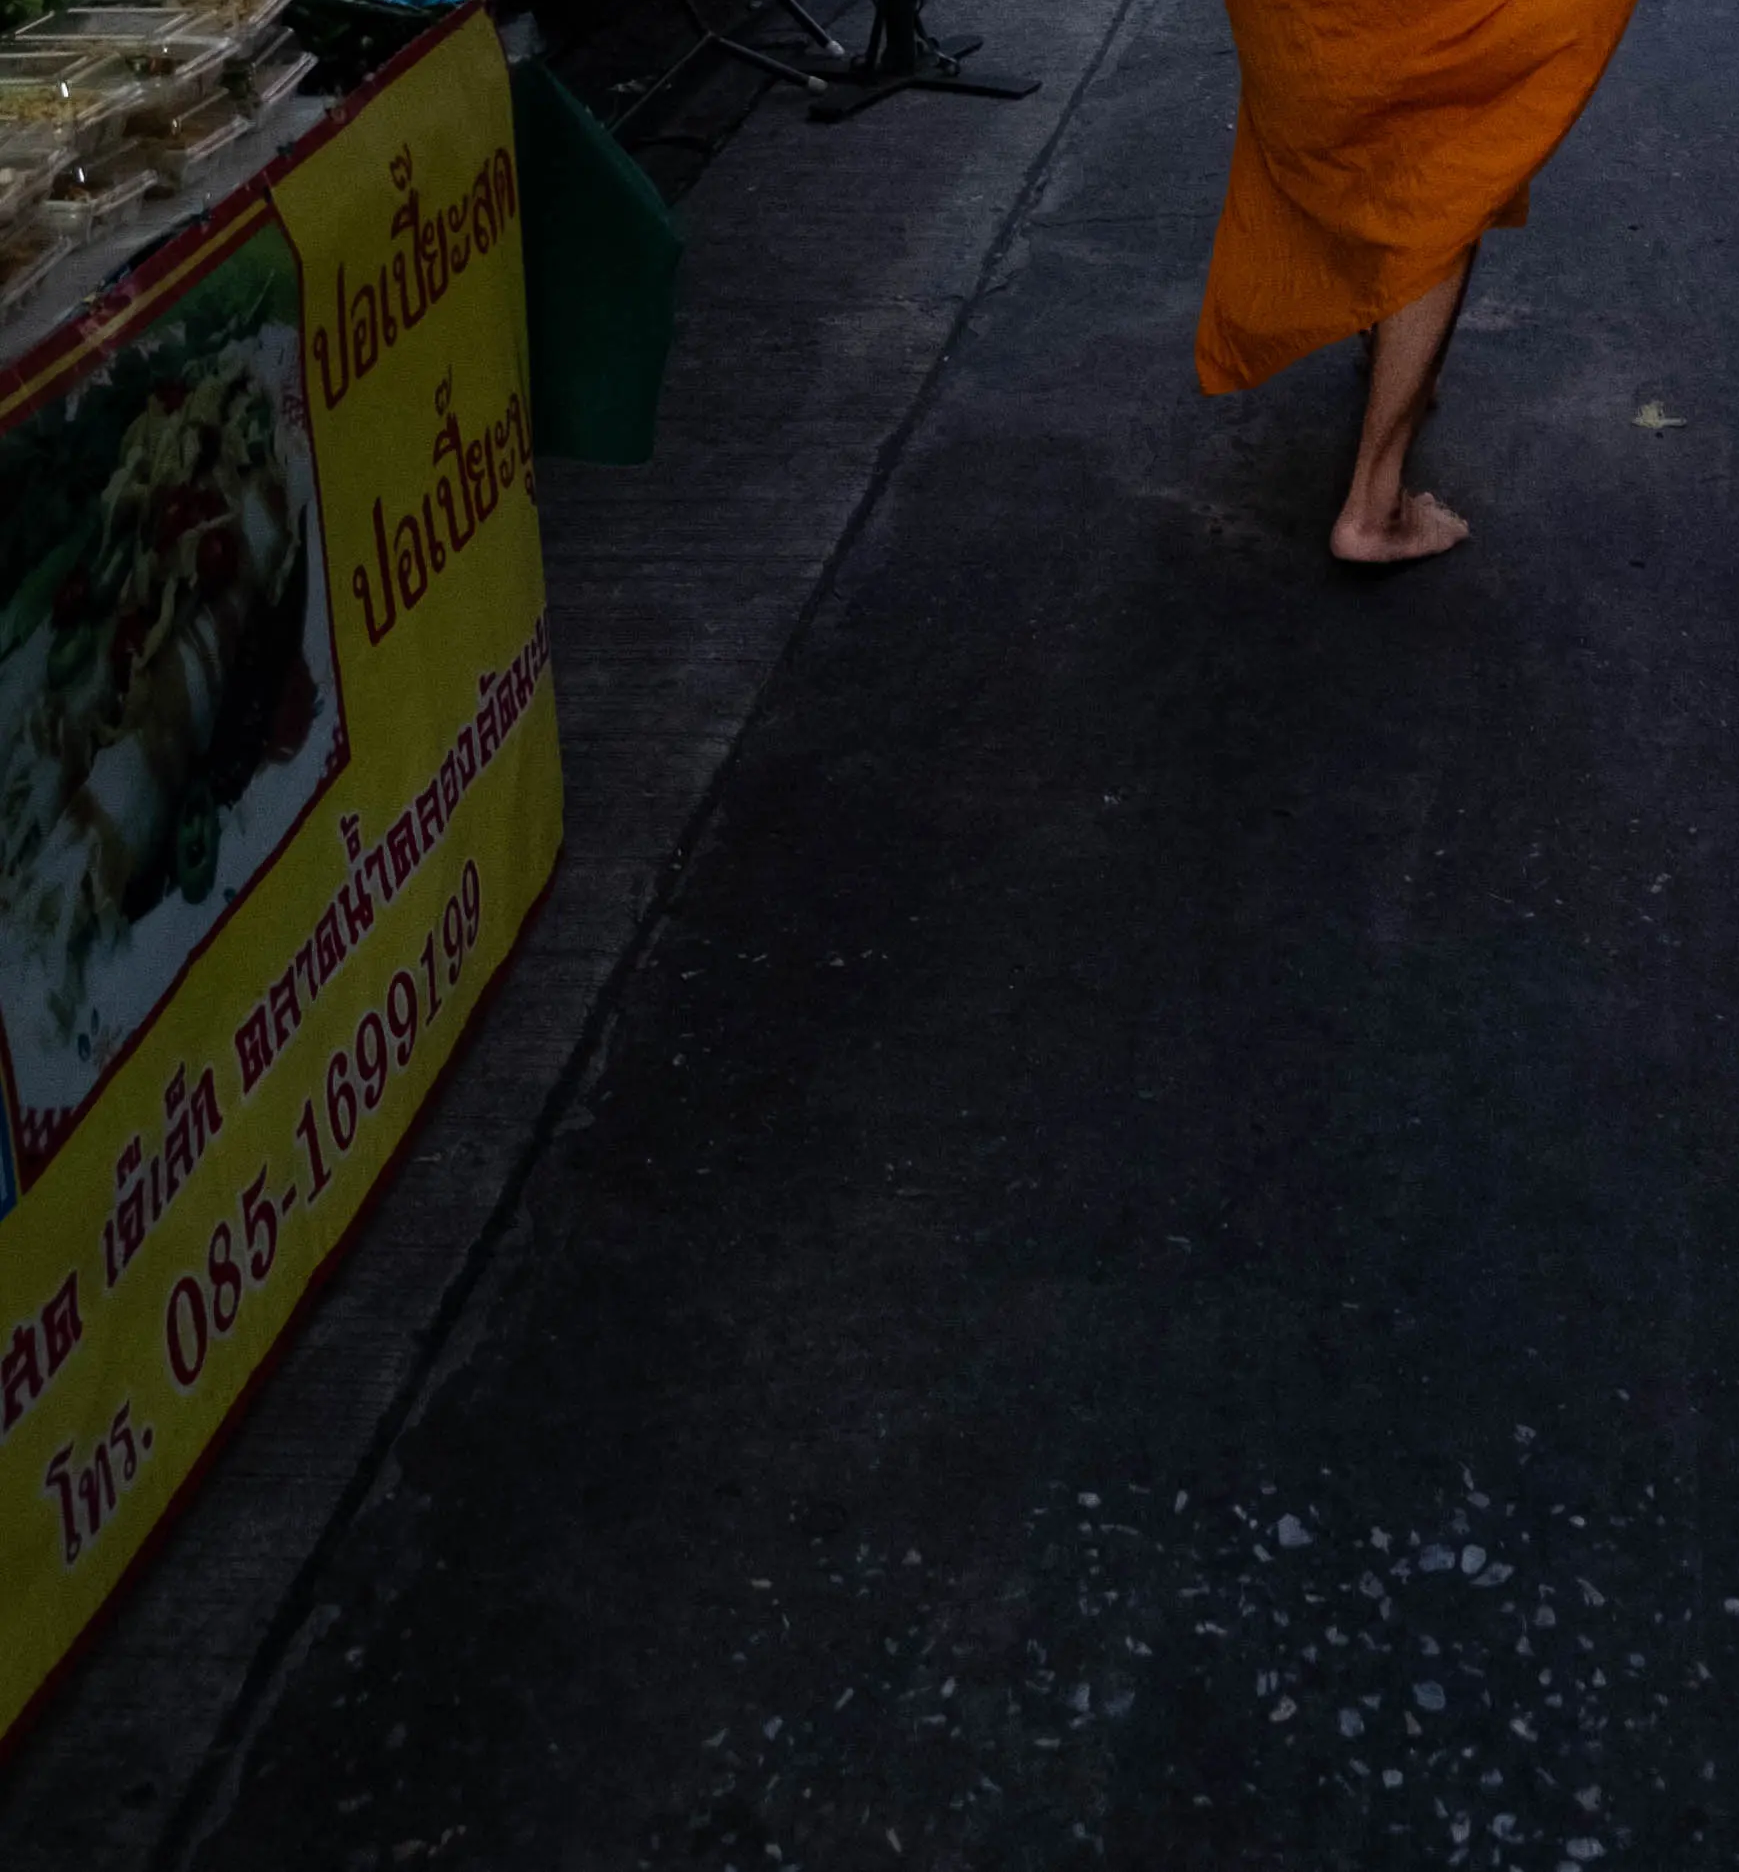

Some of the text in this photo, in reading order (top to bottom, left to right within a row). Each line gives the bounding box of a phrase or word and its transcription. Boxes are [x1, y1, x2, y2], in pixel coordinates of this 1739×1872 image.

[313, 143, 516, 411] ปอเปี๊ยะสด
[46, 857, 482, 1565] โทร. 085-1699199
